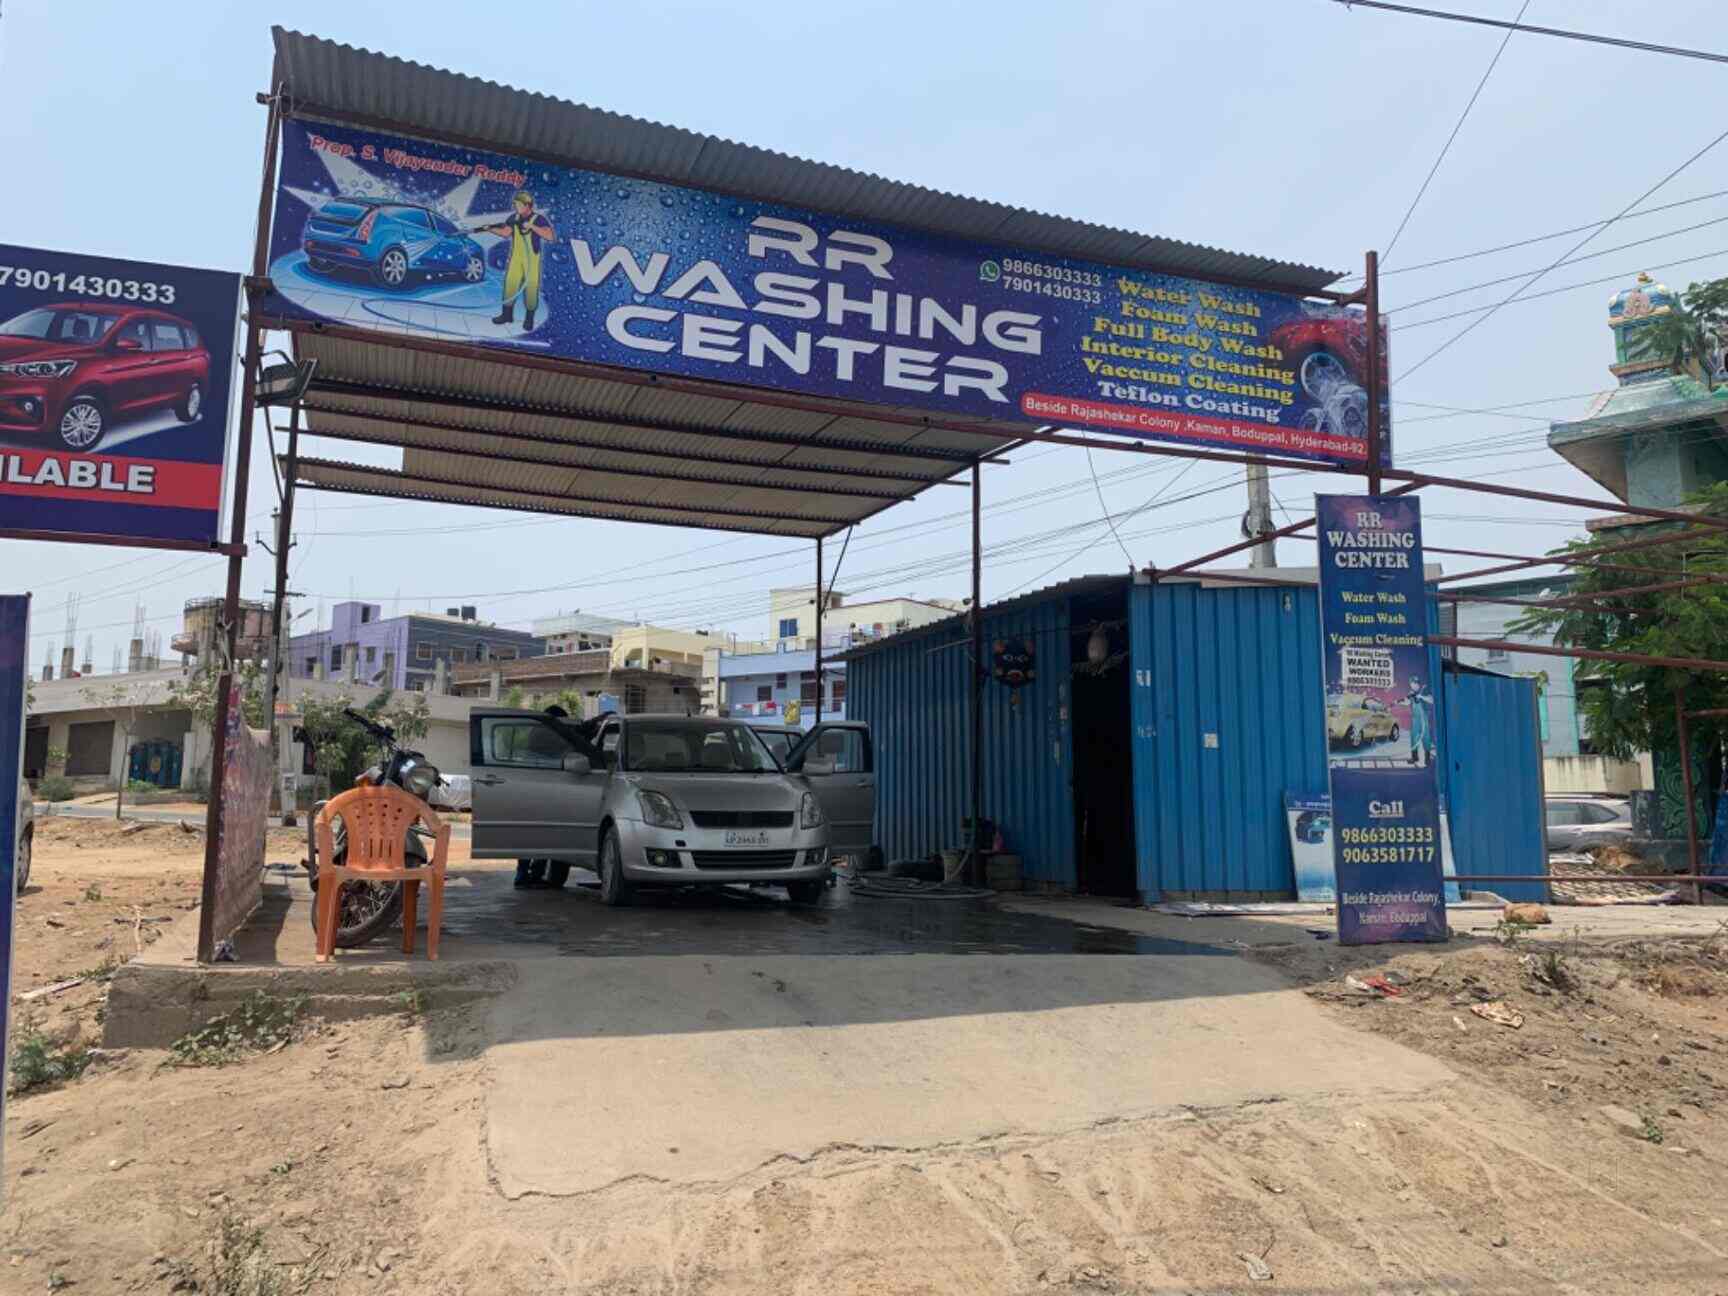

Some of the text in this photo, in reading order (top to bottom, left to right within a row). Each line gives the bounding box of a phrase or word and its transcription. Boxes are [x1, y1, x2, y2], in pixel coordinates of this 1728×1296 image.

[361, 144, 378, 161] S.
[474, 163, 527, 188] Reddy
[749, 216, 894, 281] RR
[0, 265, 176, 304] 7901430333
[1002, 258, 1101, 288] 9866303333
[570, 239, 1042, 355] WASHING
[1002, 275, 1101, 305] 7901430333
[1117, 277, 1261, 318] Water Wash
[1121, 301, 1258, 337] Foam Wash
[605, 304, 1009, 404] CENTER
[1094, 316, 1283, 361] Full Body Wash
[1081, 335, 1296, 386] Interior Cleaning
[1084, 357, 1295, 406] Vaccum Cleaning
[1097, 380, 1282, 424] Teflon Coating
[1026, 397, 1068, 415] Beside
[1071, 403, 1137, 424] Rajashekar
[1139, 414, 1180, 433] Colony
[1232, 425, 1289, 446] Boduppal,
[1357, 511, 1383, 528] RR
[1326, 531, 1416, 549] WASHING
[1334, 551, 1410, 569] CENTER
[1342, 591, 1407, 603] Water Wash
[1344, 612, 1406, 624] Foam Wash
[1376, 633, 1423, 647] Cleaning
[1346, 657, 1390, 668] WANTED
[1368, 800, 1404, 816] Call
[1341, 827, 1433, 843] 9866303333
[1343, 847, 1435, 865] 9063581717
